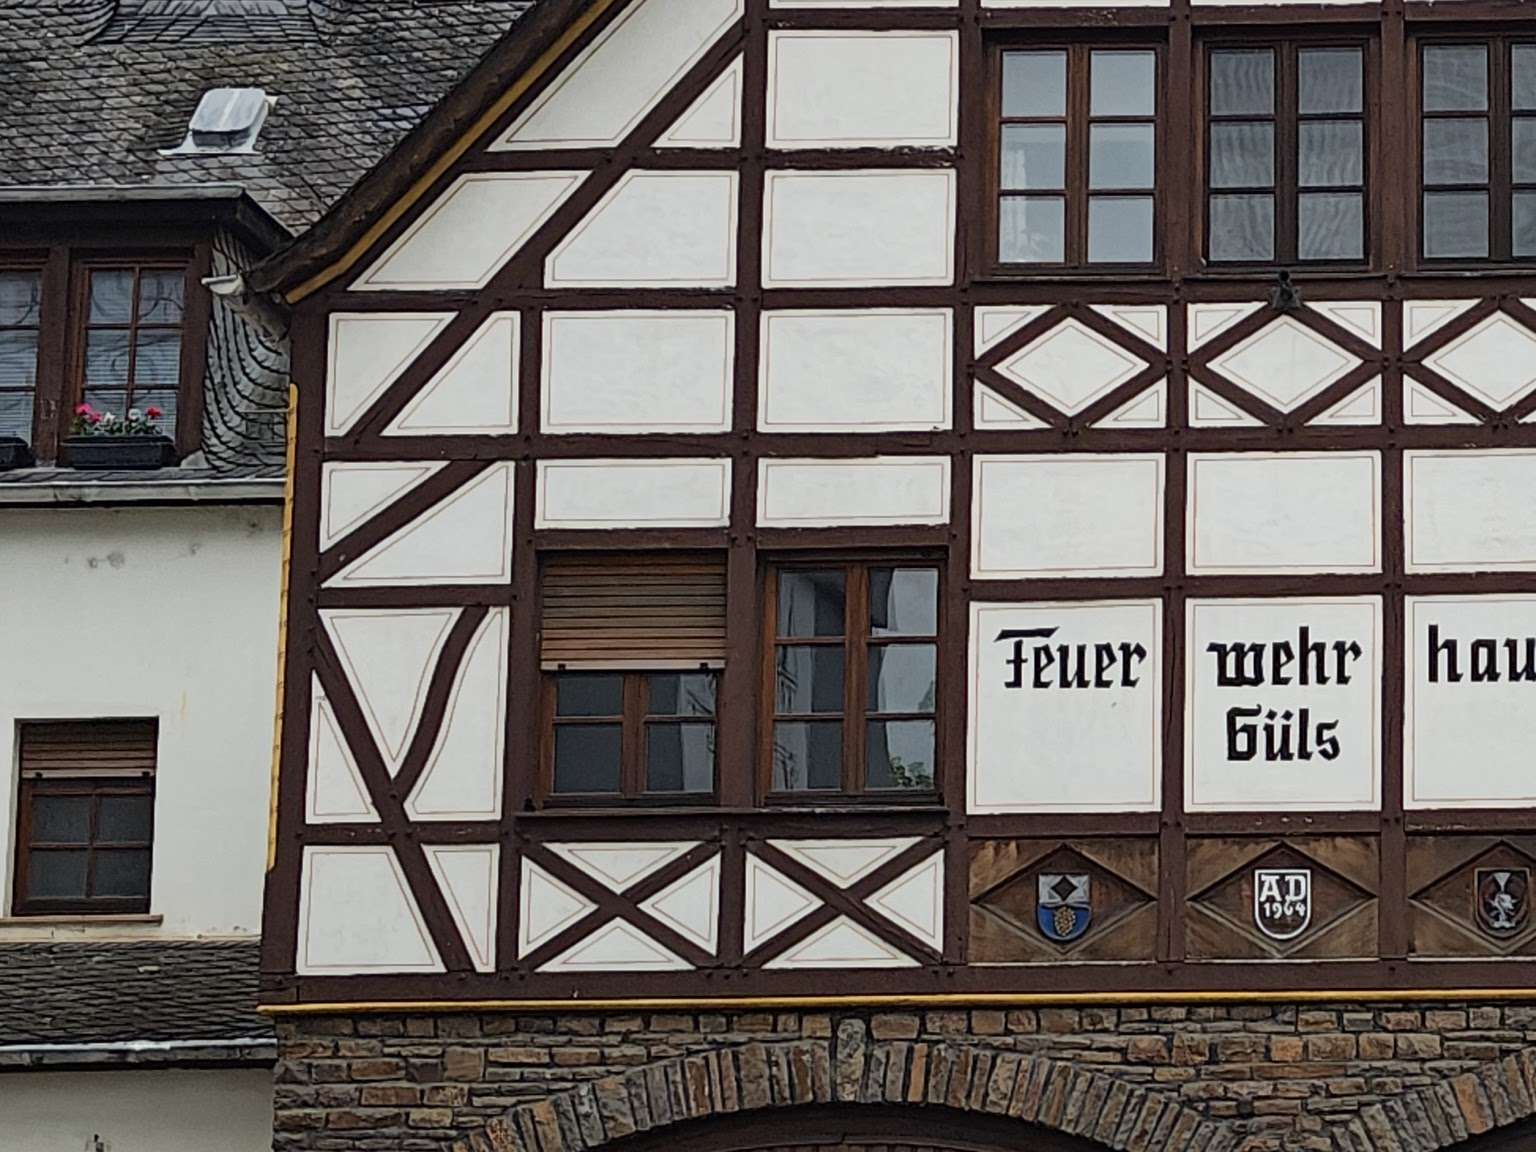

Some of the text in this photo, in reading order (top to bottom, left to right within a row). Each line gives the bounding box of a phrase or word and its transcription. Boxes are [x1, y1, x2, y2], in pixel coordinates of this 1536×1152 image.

[994, 626, 1148, 689] Feuer
[1206, 626, 1362, 687] wehr
[1225, 703, 1341, 762] Güls
[1263, 900, 1306, 919] 1964
